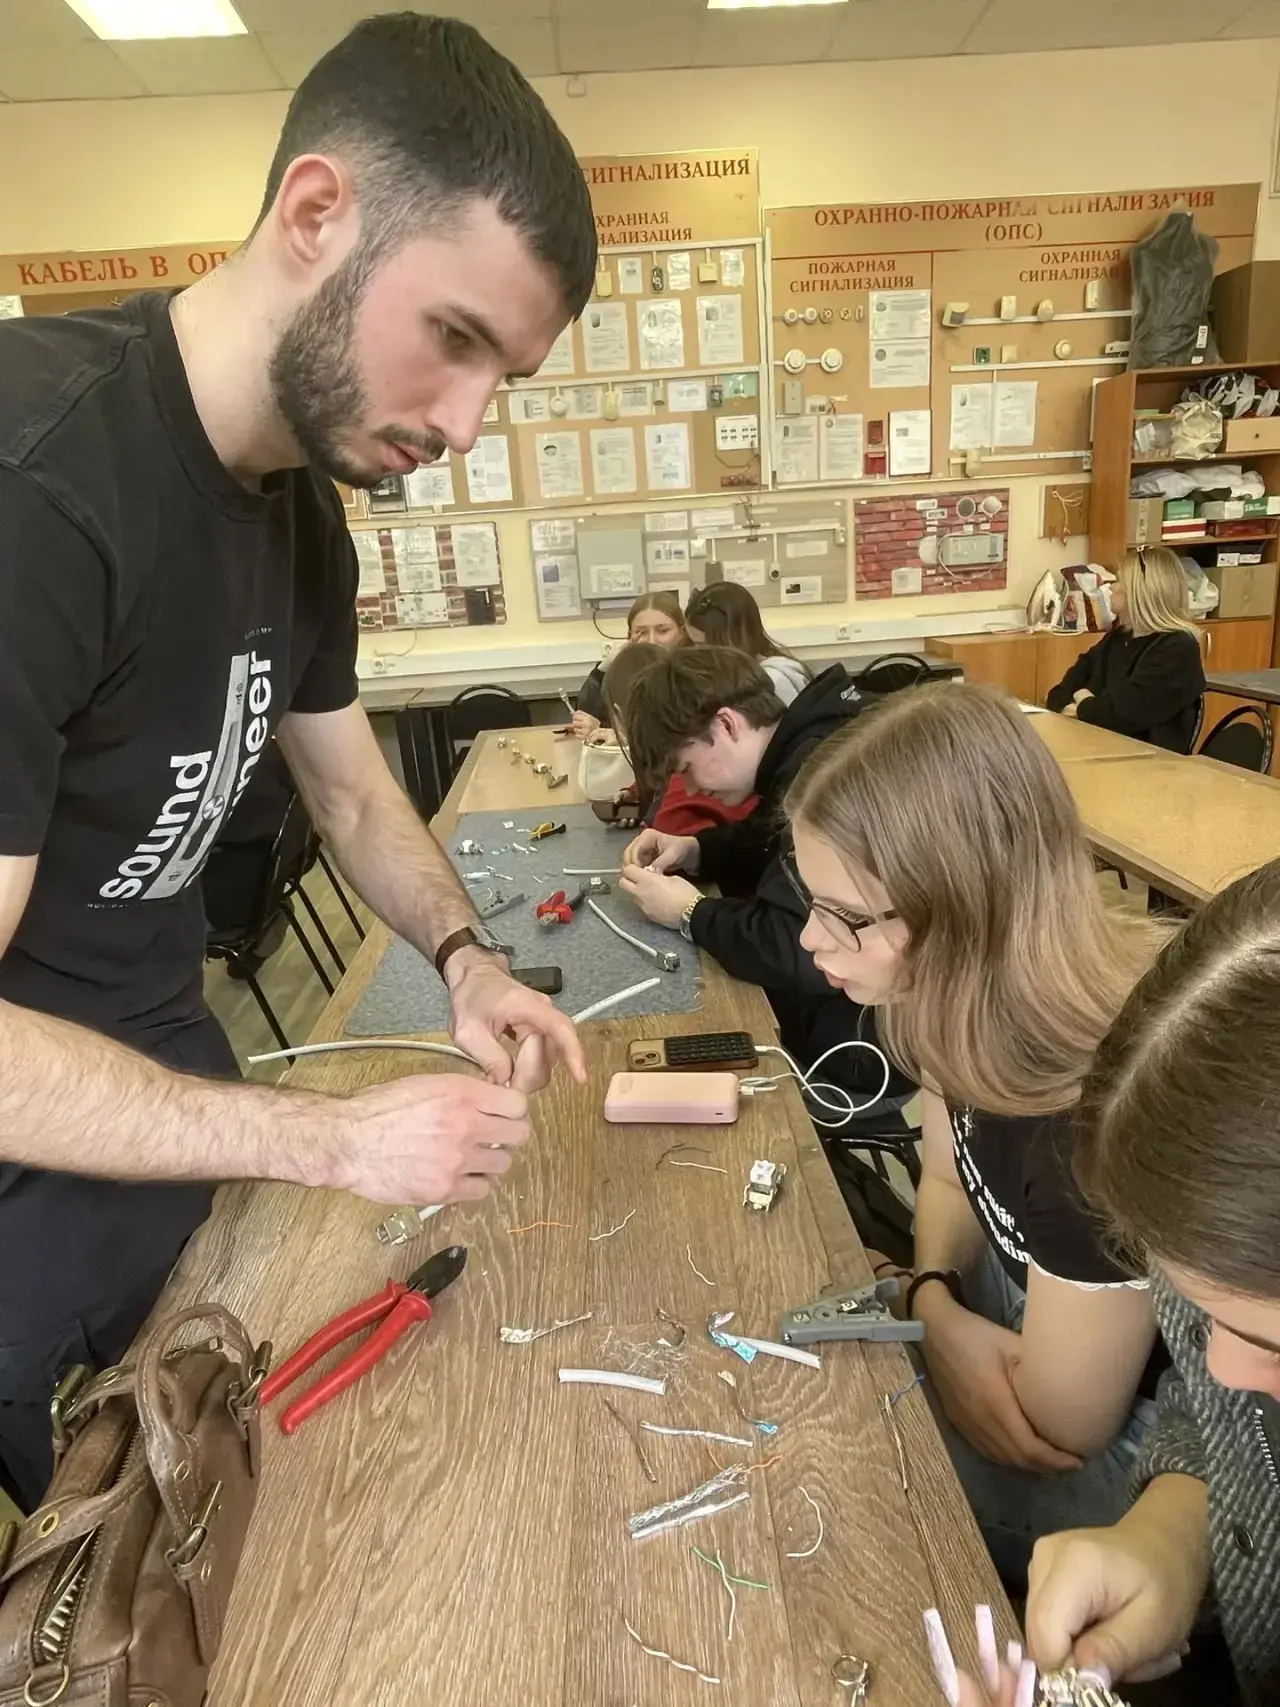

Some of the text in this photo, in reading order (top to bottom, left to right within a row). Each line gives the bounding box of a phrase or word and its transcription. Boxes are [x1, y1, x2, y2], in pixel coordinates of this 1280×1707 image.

[984, 222, 1043, 242] (ОПС)
[1040, 248, 1121, 264] ОХРАННАЯ
[18, 257, 138, 285] КАБЕЛЬ
[149, 255, 169, 278] В
[808, 259, 896, 275] ПОЖАРНАЯ
[790, 275, 914, 293] СИГНАЛИЗАЦИЯ
[99, 750, 213, 899] sound
